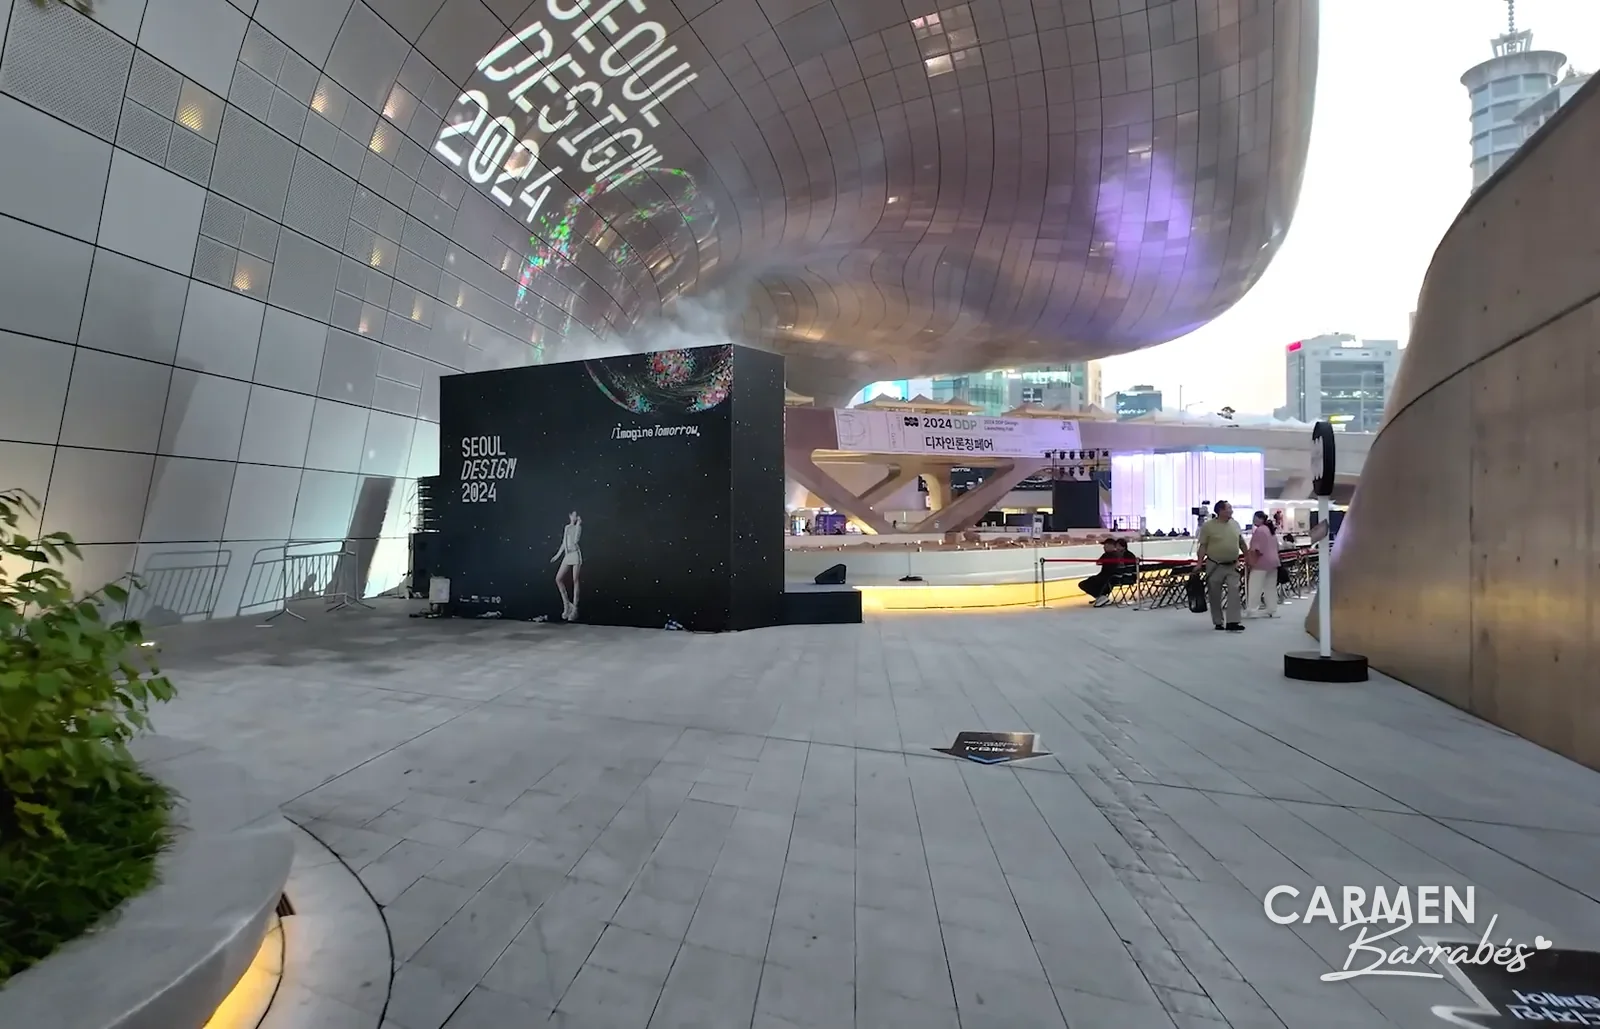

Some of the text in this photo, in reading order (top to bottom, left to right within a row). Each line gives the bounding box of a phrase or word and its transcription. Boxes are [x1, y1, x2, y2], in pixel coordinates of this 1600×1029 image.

[476, 21, 663, 192] DESIGN
[435, 90, 562, 223] 2024
[923, 417, 977, 430] 2024 DDP
[462, 435, 506, 457] SEOUL
[925, 436, 994, 451] 디자인론칭페어
[460, 458, 517, 480] DESIGN
[462, 481, 497, 503] 2024
